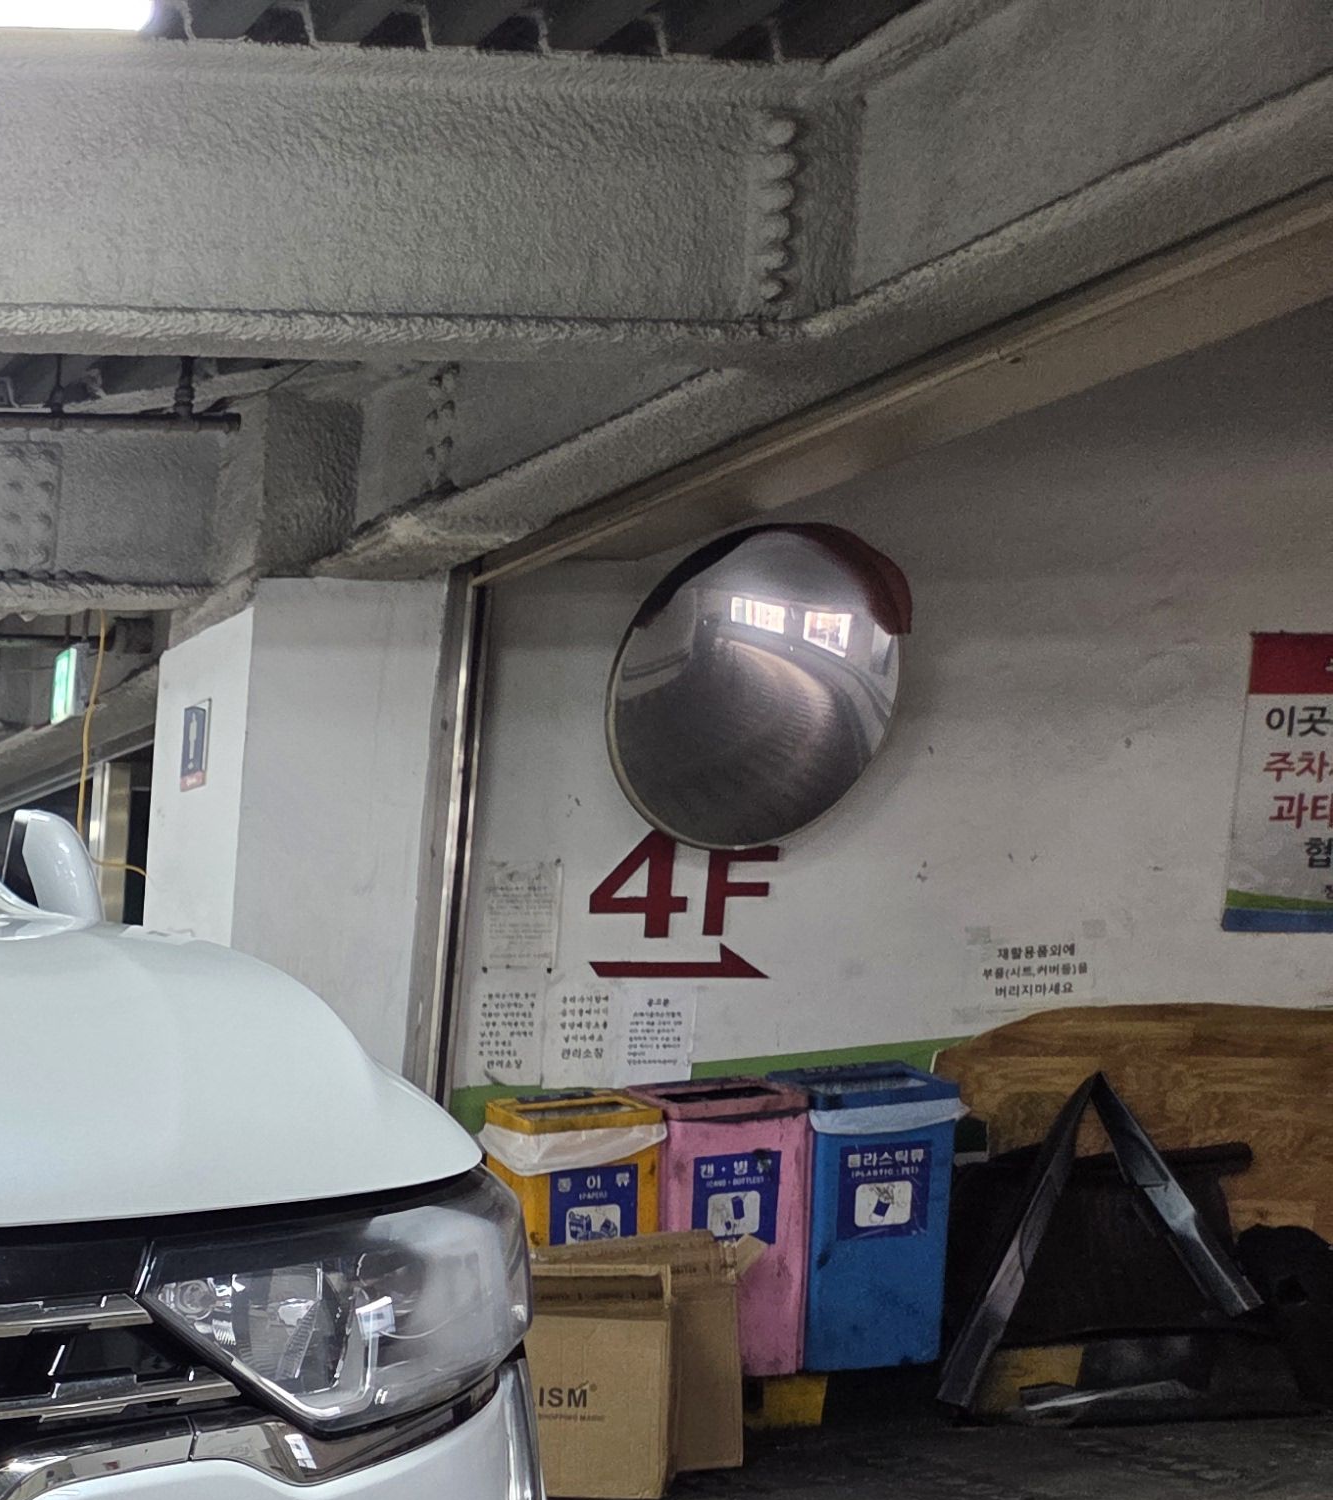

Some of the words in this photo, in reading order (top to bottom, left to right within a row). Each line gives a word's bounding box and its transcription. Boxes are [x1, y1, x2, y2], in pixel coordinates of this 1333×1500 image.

[1263, 750, 1333, 783] 주차
[589, 829, 779, 939] 4F
[536, 1386, 588, 1408] ISM
